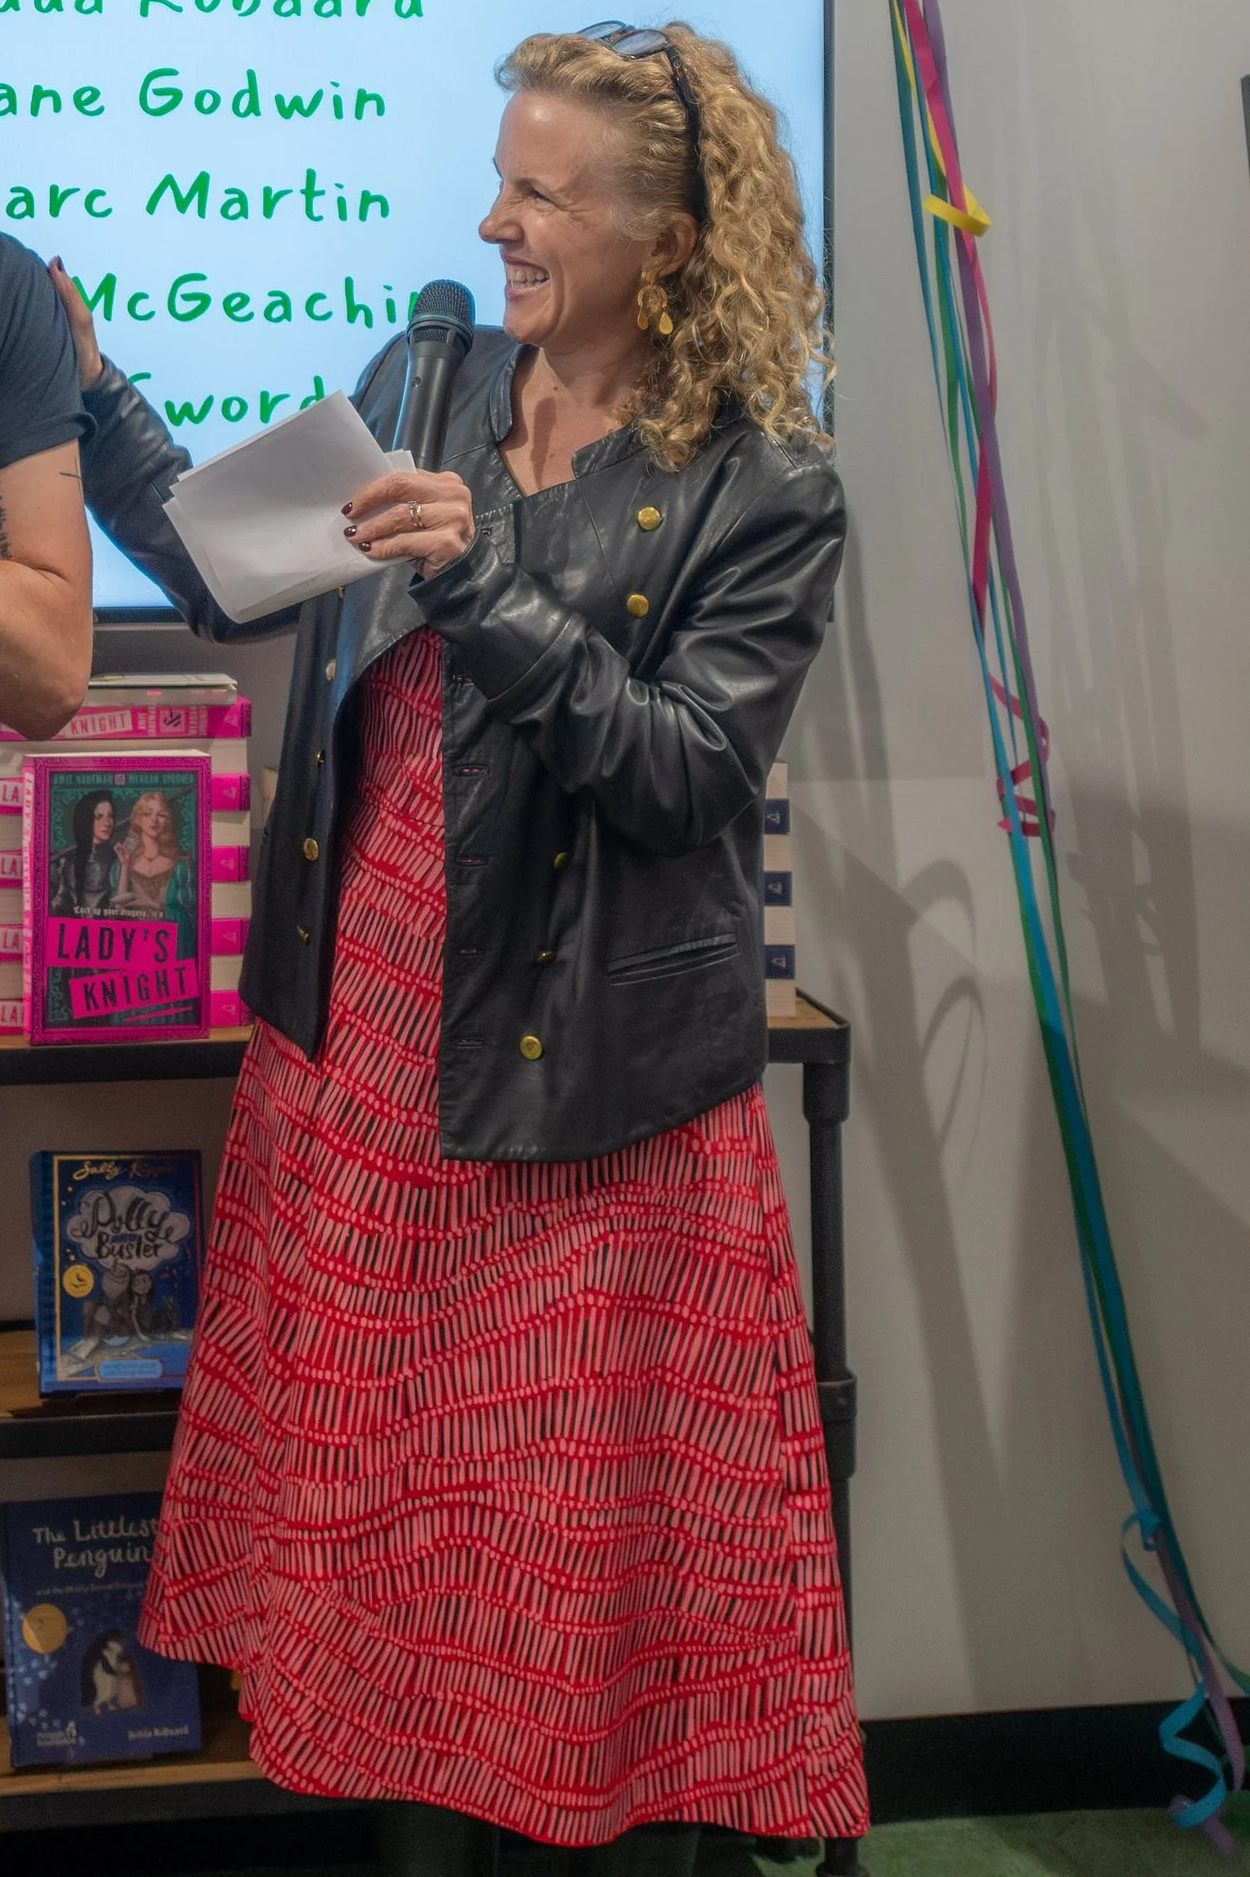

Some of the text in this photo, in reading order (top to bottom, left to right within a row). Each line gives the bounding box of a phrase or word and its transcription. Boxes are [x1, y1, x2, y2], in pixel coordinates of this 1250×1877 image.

[139, 68, 387, 121] Godwin
[146, 169, 390, 222] Martin
[71, 713, 126, 735] KNIGHT
[57, 923, 170, 963] LADY'S
[83, 966, 186, 1012] KNIGHT
[96, 1231, 163, 1260] Buster
[32, 1527, 66, 1544] The
[53, 1543, 150, 1579] Penguin
